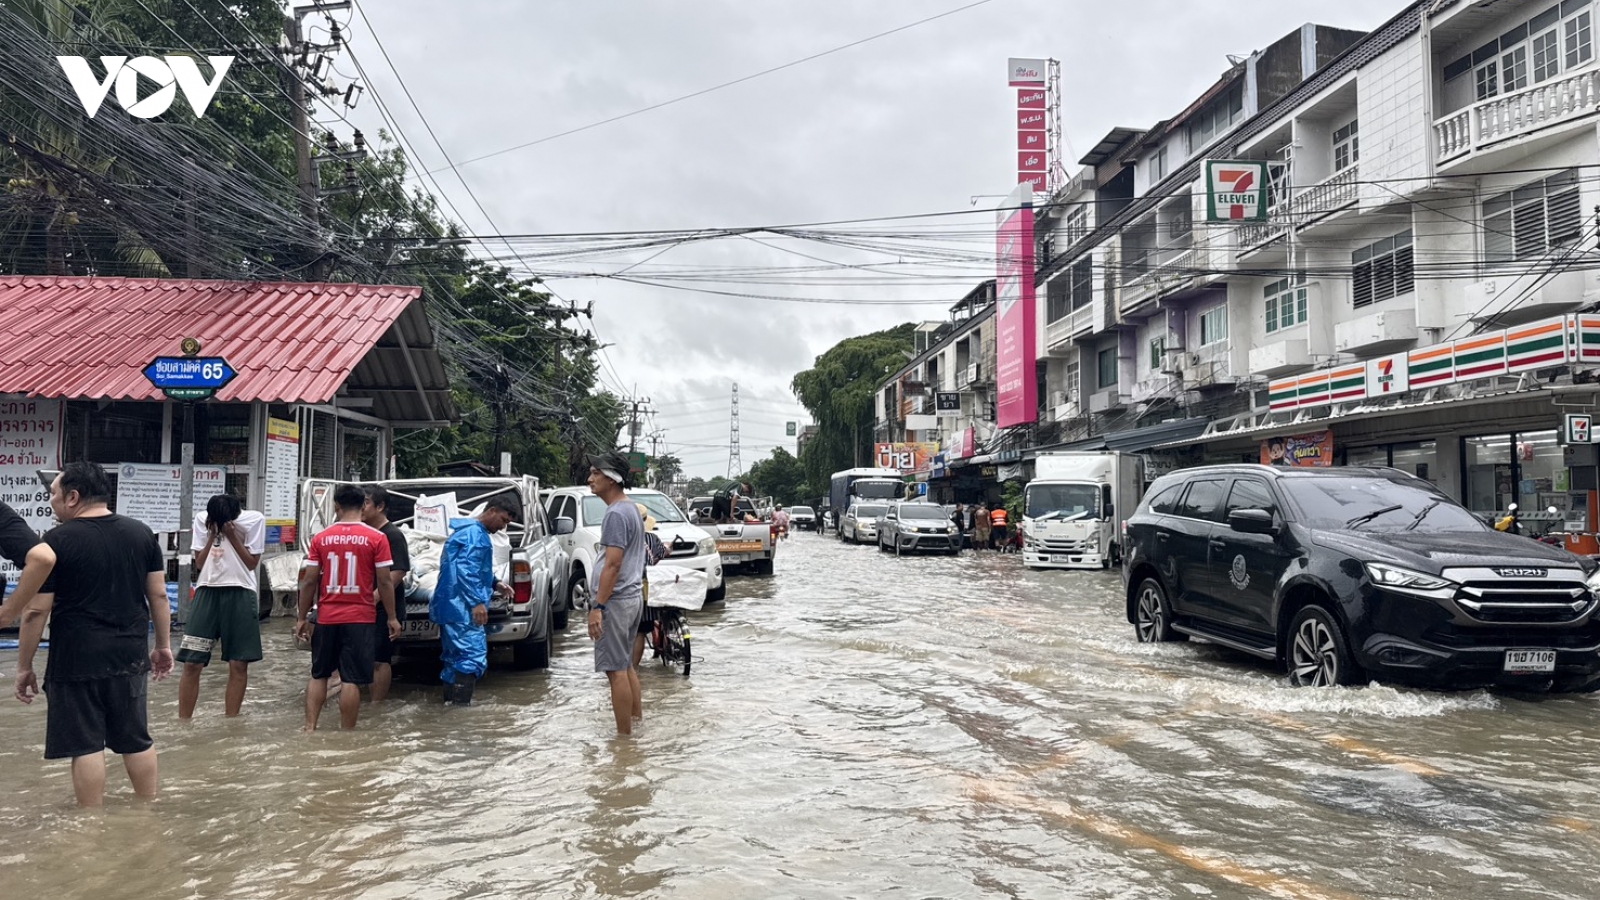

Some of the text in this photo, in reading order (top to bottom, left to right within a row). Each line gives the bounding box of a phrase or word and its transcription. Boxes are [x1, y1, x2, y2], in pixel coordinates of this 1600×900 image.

[1219, 170, 1254, 219] 7
[202, 363, 223, 380] 65
[1378, 359, 1392, 392] 7
[0, 402, 36, 414] ะกาศ
[39, 438, 43, 448] 1
[0, 449, 47, 465] 24 ชั่วโมง
[878, 444, 915, 468] ป้าย
[172, 468, 219, 480] ปะกาศ
[35, 492, 50, 502] 69
[37, 507, 52, 517] 69
[326, 551, 360, 594] 11
[411, 621, 436, 631] 9297
[1530, 652, 1554, 662] 7106
